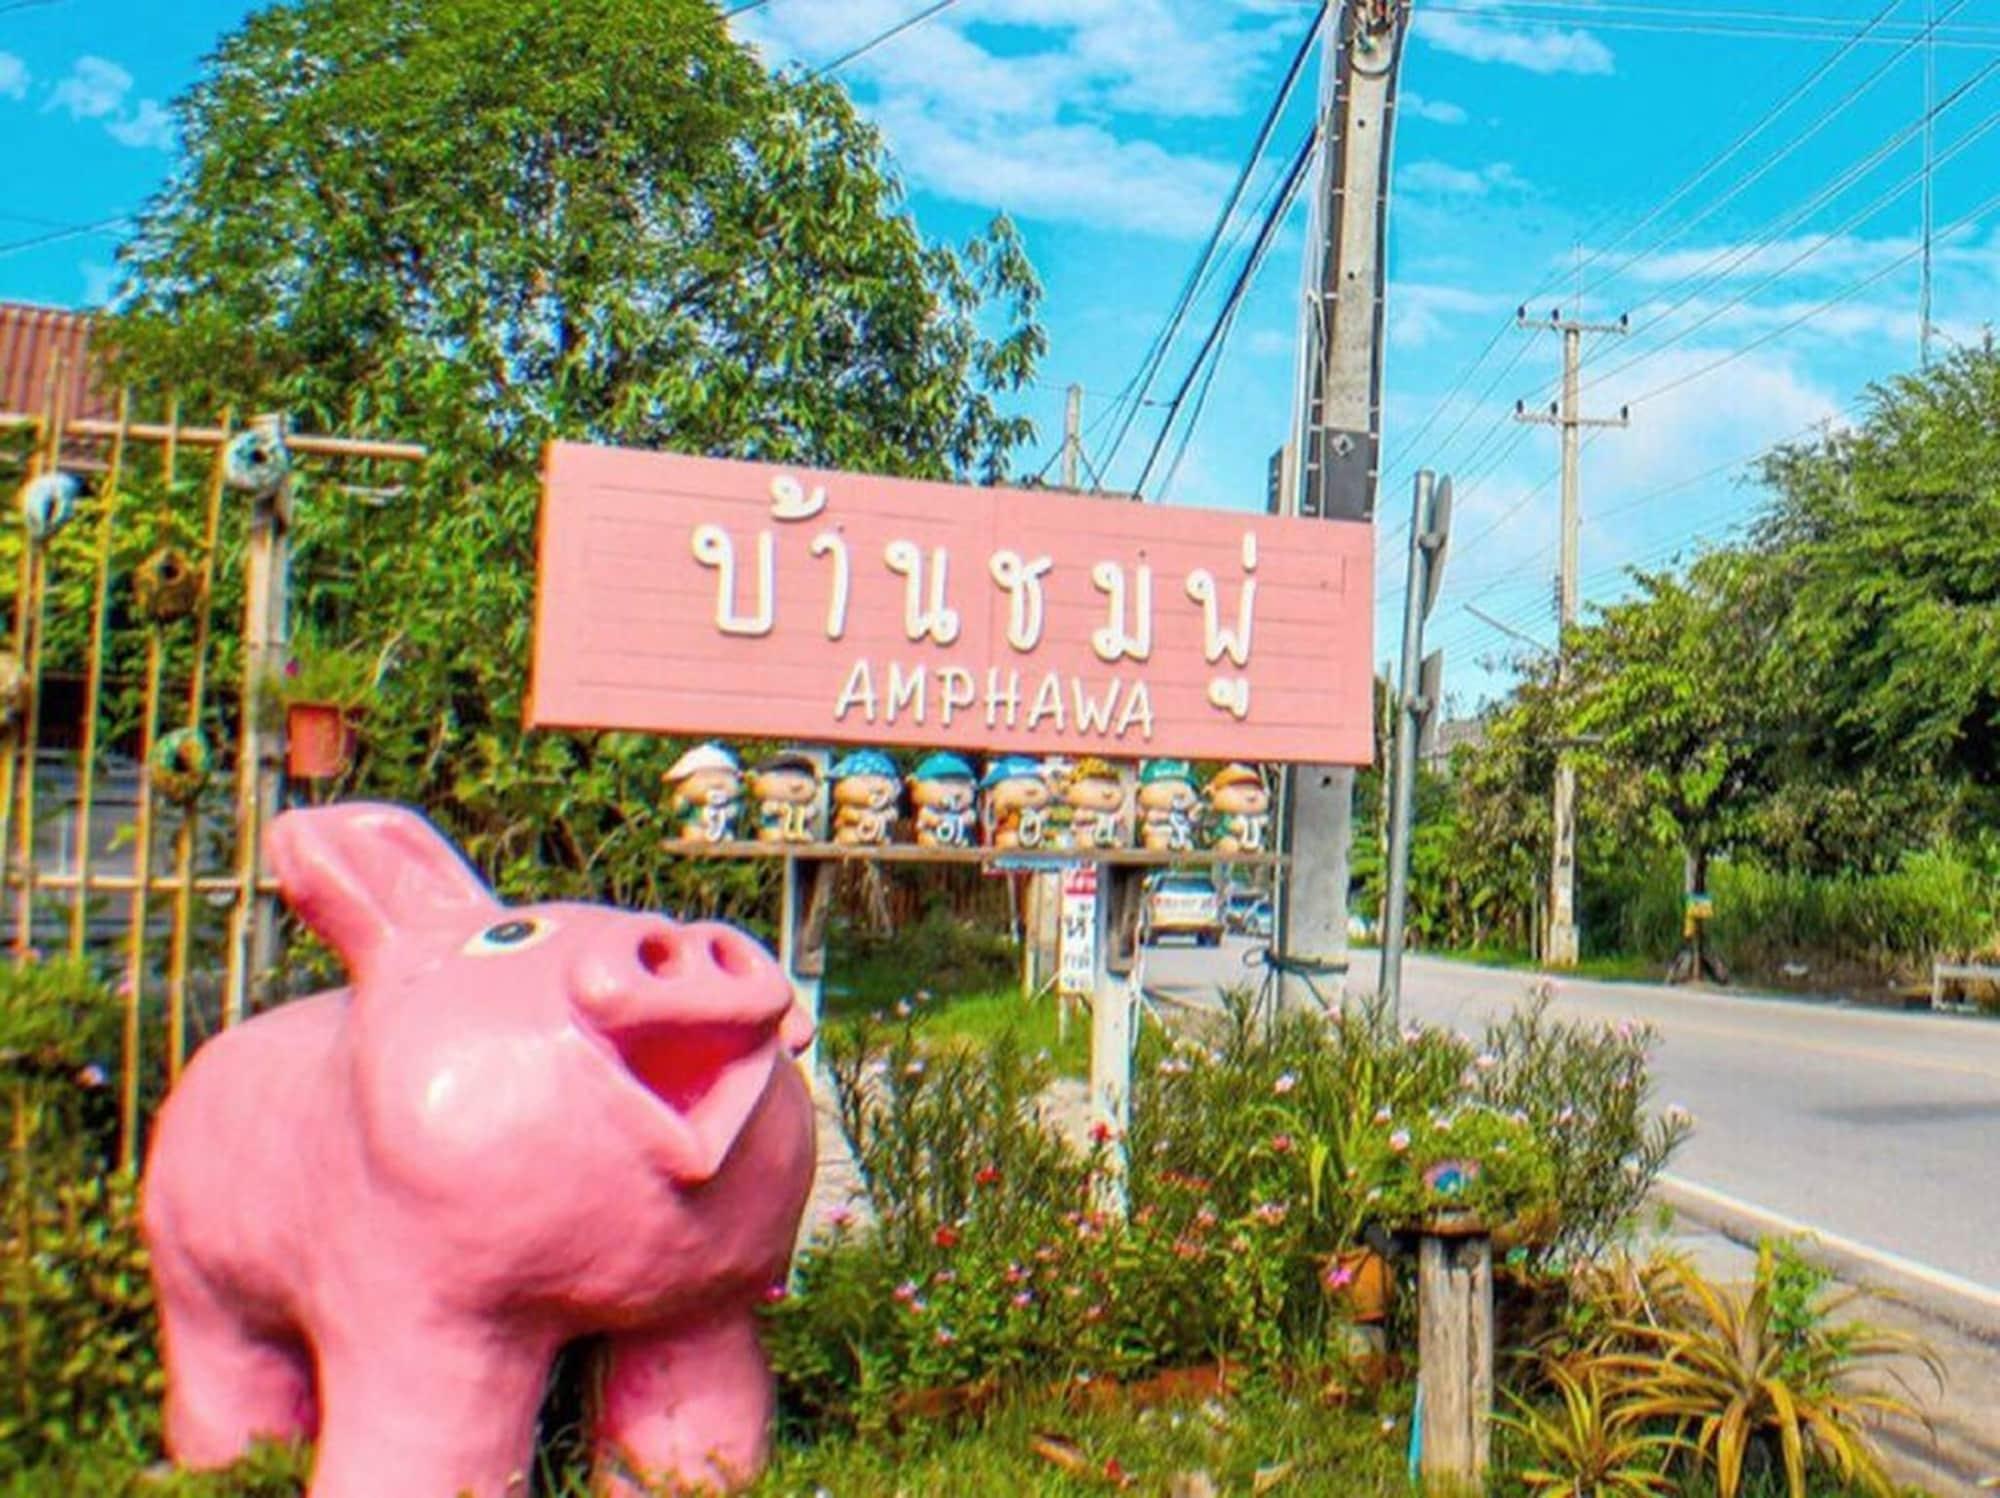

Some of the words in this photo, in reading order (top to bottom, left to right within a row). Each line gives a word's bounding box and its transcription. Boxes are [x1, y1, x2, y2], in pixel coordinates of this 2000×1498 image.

[692, 475, 1257, 720] บ้านชมพู่
[834, 660, 1153, 741] AMPHAWA
